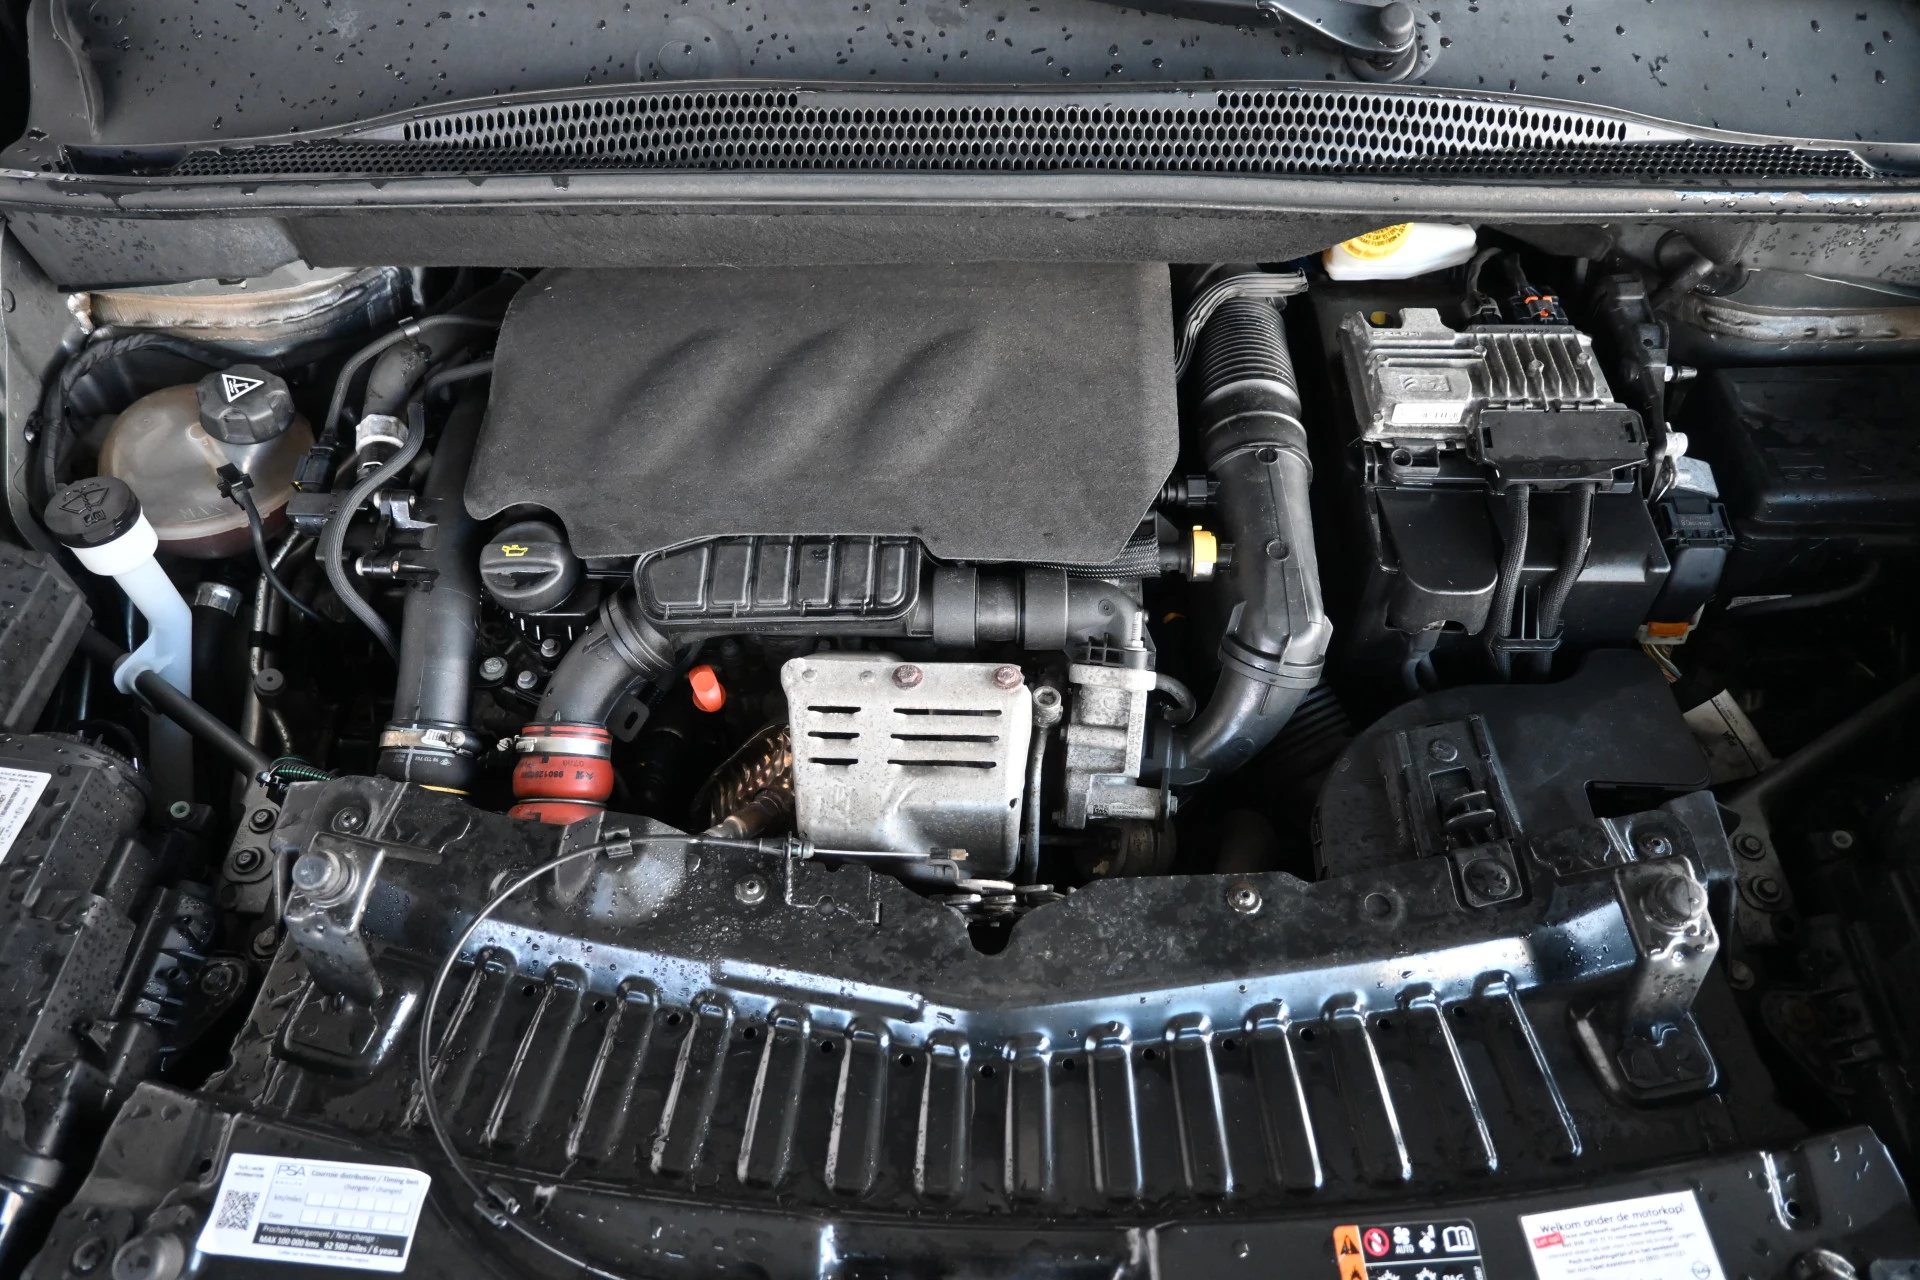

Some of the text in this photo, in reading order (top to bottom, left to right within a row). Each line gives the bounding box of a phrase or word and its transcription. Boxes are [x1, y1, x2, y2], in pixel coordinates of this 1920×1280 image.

[277, 1164, 306, 1177] PSA
[340, 1172, 377, 1182] distribution
[1540, 1202, 1686, 1233] Welkom onder de motorkap!
[262, 1224, 290, 1233] Prochain
[291, 1226, 330, 1239] changement
[336, 1231, 354, 1240] Next
[259, 1235, 277, 1243] MAX
[277, 1236, 291, 1244] 100
[291, 1237, 305, 1246] 000
[324, 1241, 334, 1249] 62
[334, 1242, 348, 1251] 500
[348, 1243, 368, 1253] miles
[378, 1247, 399, 1256] years
[1395, 1244, 1415, 1254] AUTO
